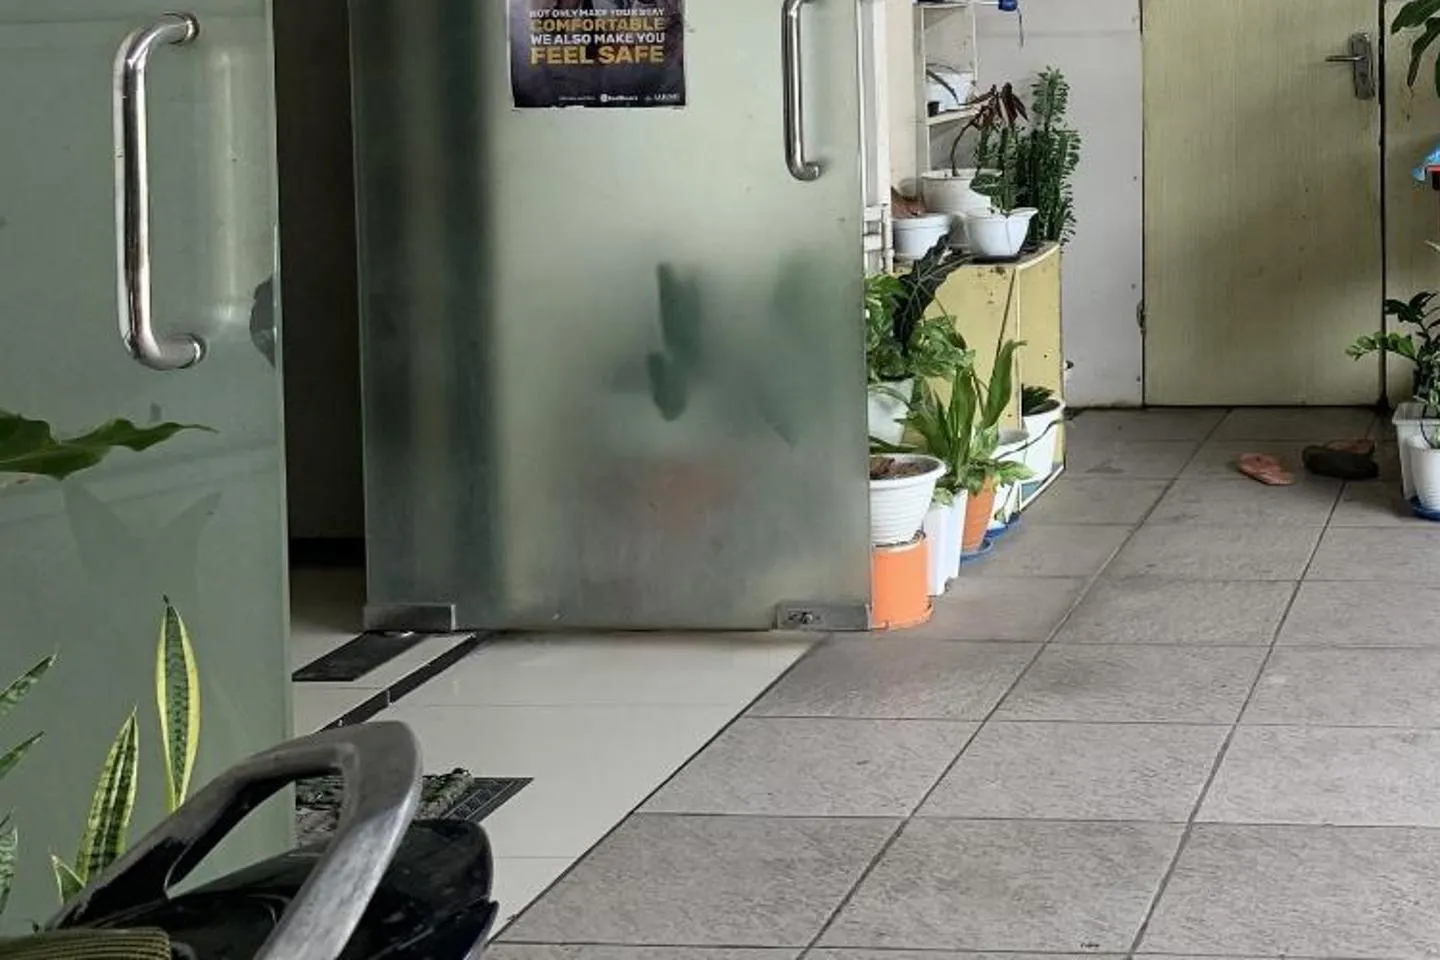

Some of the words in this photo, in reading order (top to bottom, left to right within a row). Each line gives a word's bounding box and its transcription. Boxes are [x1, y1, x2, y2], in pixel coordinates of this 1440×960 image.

[529, 9, 551, 18] NOT
[551, 8, 579, 18] ONLY
[530, 17, 665, 32] COMFORTABLE
[530, 33, 552, 45] WE
[553, 33, 592, 45] ALSO
[594, 33, 635, 44] MAKE
[636, 32, 665, 43] YOU
[530, 46, 595, 65] FEEL
[598, 45, 665, 64] SAFE
